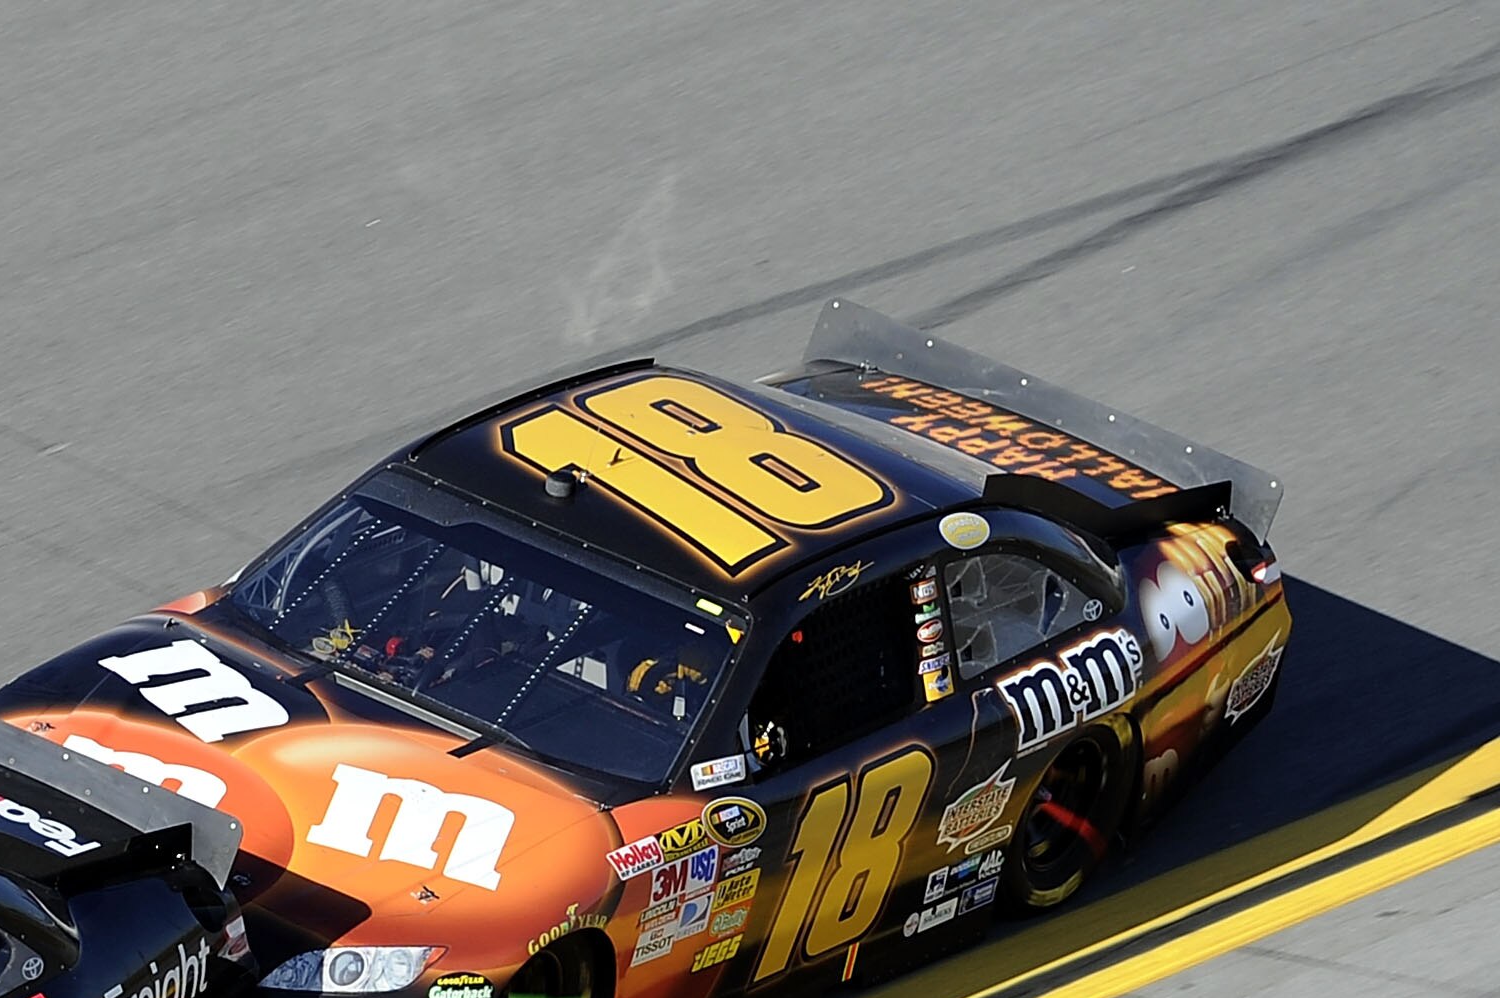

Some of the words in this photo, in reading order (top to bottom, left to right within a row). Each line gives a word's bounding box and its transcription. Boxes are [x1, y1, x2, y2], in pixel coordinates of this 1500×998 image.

[890, 412, 1078, 483] HAPPY
[500, 373, 896, 578] 18
[98, 638, 290, 743] m
[305, 762, 516, 891] m
[609, 841, 662, 872] Holley
[652, 859, 689, 902] 3M
[690, 847, 716, 882] USG
[749, 743, 936, 987] 18
[528, 902, 607, 956] GOODYEAR
[635, 935, 675, 958] TISSOT
[691, 934, 743, 973] JEGS
